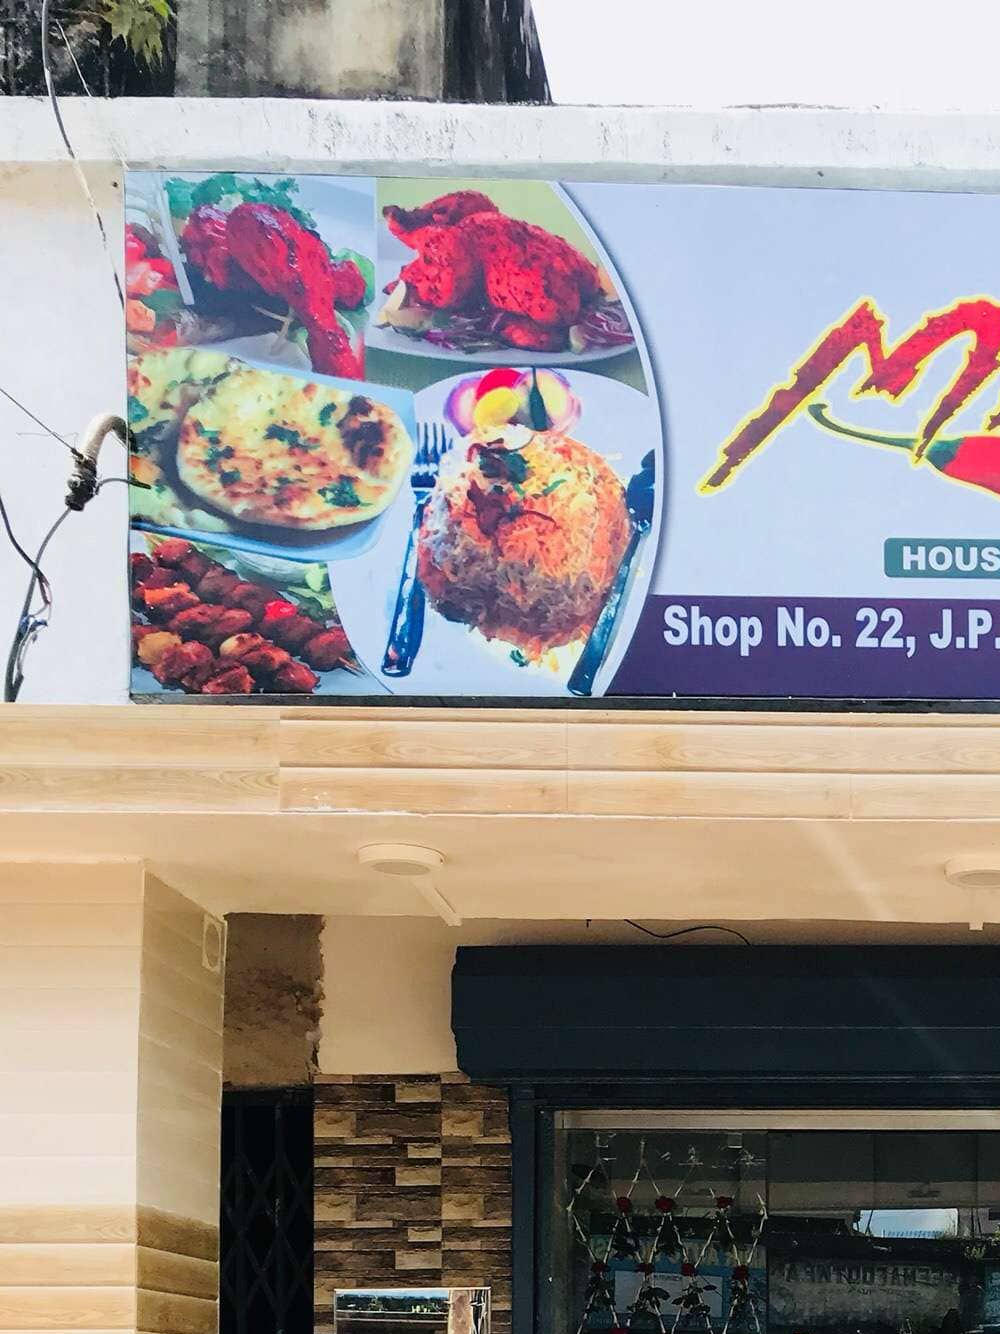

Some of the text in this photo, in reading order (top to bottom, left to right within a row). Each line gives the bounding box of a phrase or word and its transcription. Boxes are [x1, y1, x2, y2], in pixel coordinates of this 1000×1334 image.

[663, 604, 763, 657] Shop
[776, 606, 842, 648] No.
[855, 607, 916, 658] 22,
